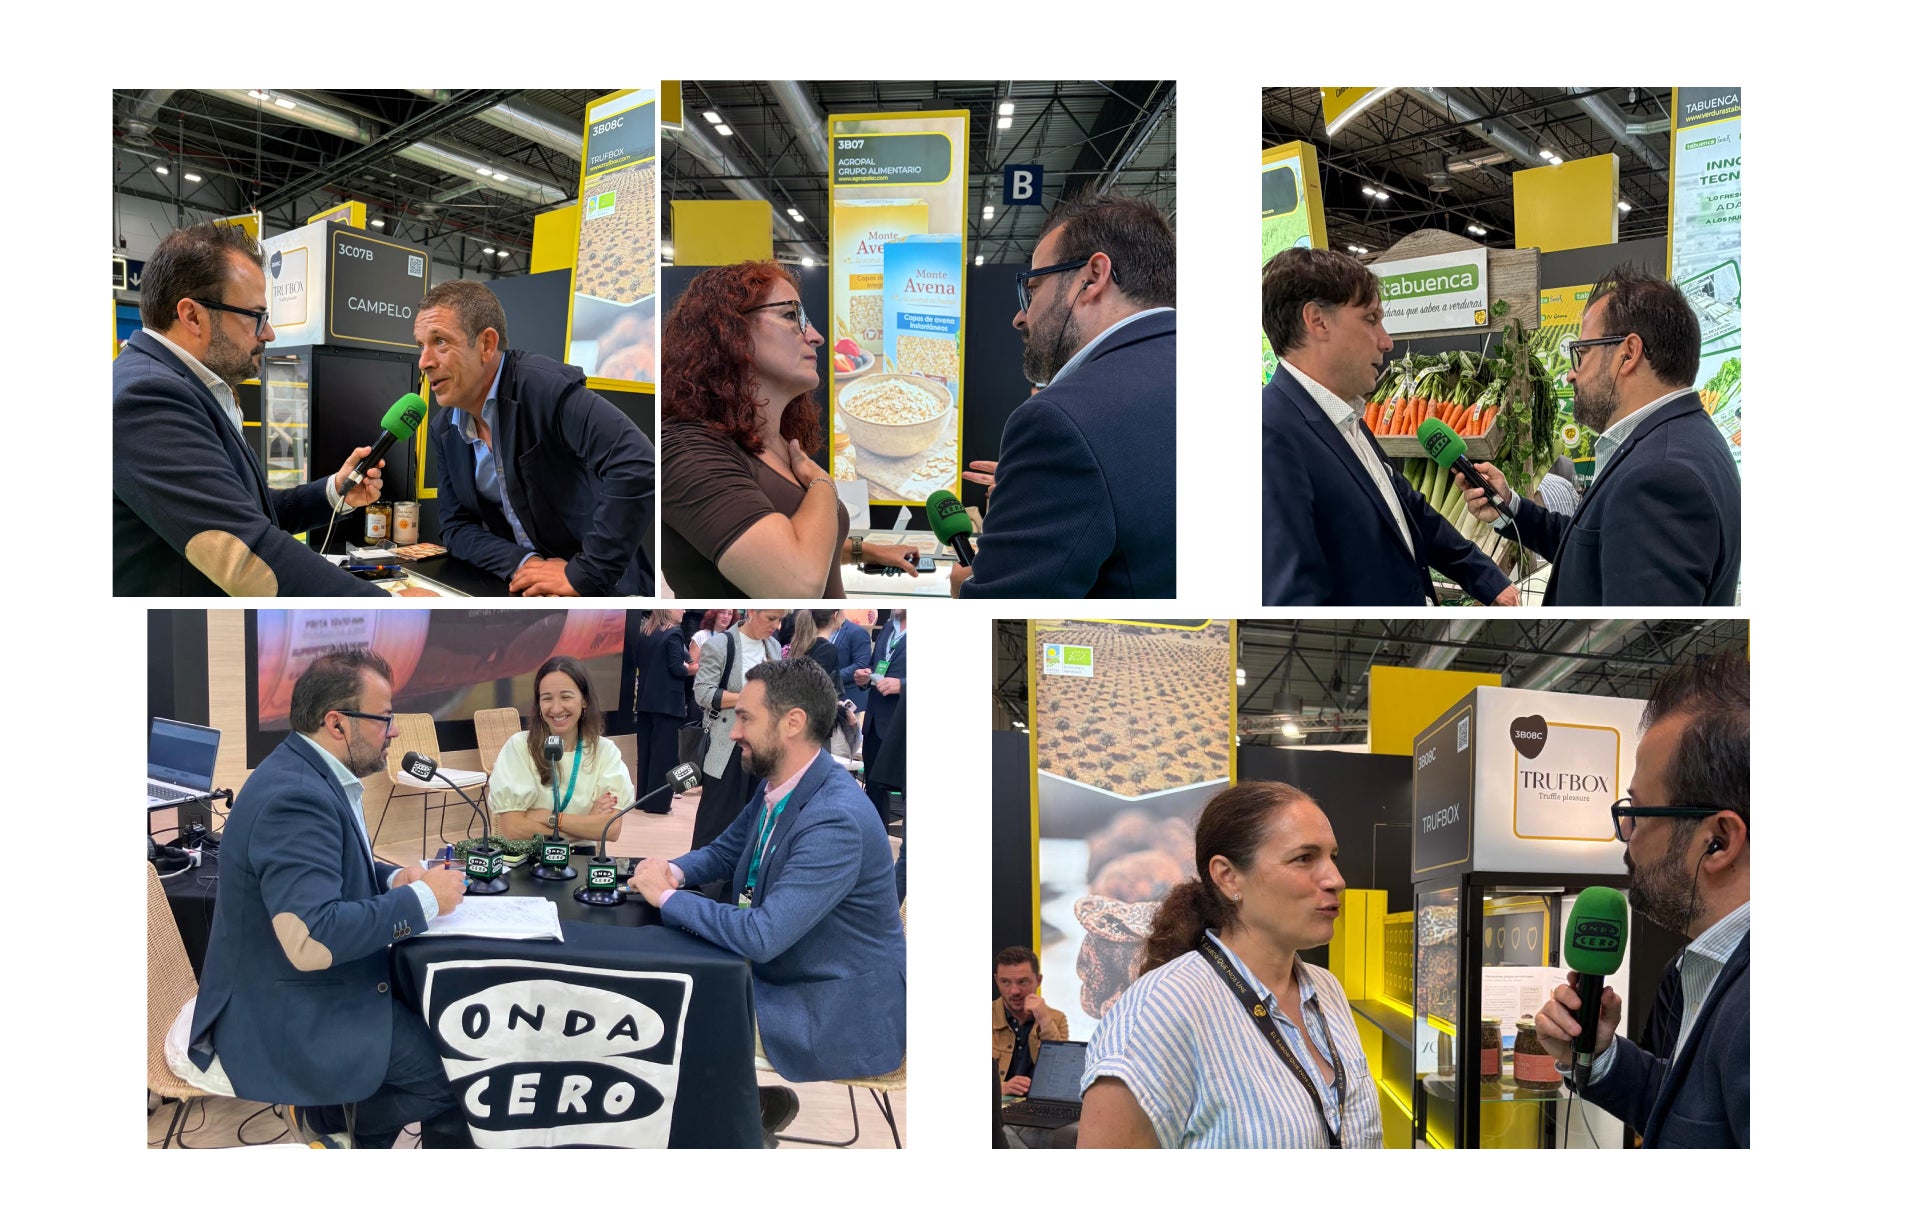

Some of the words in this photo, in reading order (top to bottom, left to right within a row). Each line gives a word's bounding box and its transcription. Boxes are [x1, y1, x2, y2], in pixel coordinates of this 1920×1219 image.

[1686, 94, 1739, 114] TABUENCA
[592, 117, 624, 137] 3B08C
[838, 139, 865, 150] 3B07
[1687, 139, 1716, 149] tabuenca
[590, 147, 625, 165] TRUFBOX
[838, 157, 876, 166] AGROPAL
[838, 167, 868, 176] GRUPO
[868, 166, 922, 175] ALIMENTARIO
[1700, 171, 1740, 185] TECN
[1012, 170, 1033, 200] B
[868, 231, 899, 240] Monte
[338, 243, 374, 261] 3C07B
[916, 269, 948, 279] Monte
[903, 277, 956, 296] Avena
[1383, 273, 1473, 297] tabuenca
[347, 296, 412, 319] CAMPELO
[1384, 306, 1405, 318] duras
[1405, 307, 1419, 318] que
[1420, 303, 1441, 314] saben
[1449, 298, 1482, 311] verduras
[904, 314, 924, 323] Copos
[924, 315, 934, 323] de
[934, 317, 956, 325] avena
[1515, 731, 1543, 739] 3B08C
[1418, 747, 1437, 770] 3B08C
[1520, 771, 1609, 793] TRUFBOX
[1539, 792, 1561, 800] Truffle
[1562, 793, 1591, 802] pleasure
[1422, 803, 1460, 834] TRUFBOX
[1581, 924, 1616, 933] ONDA
[1580, 937, 1615, 947] CERO
[1217, 958, 1229, 971] QUE
[462, 1003, 640, 1041] ONDA
[1271, 1031, 1277, 1040] EL
[1289, 1057, 1301, 1071] QUE
[465, 1072, 636, 1118] CERO
